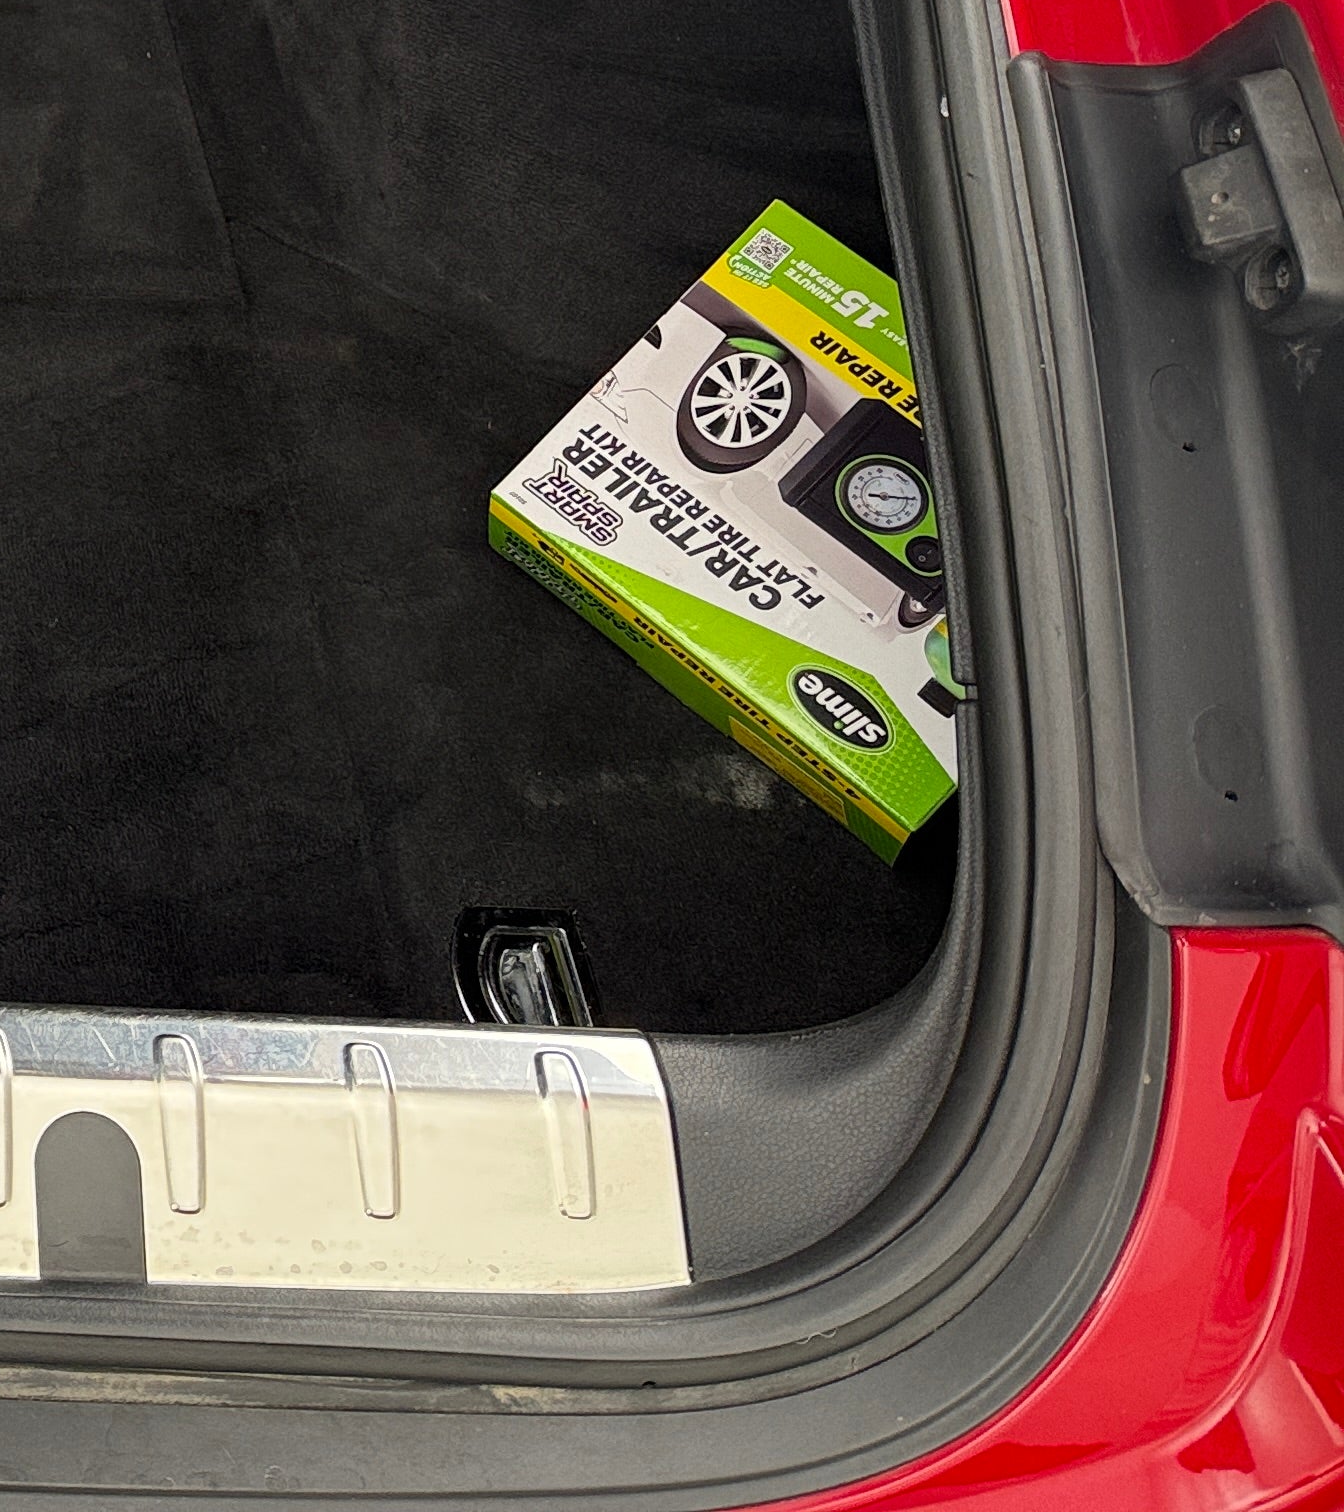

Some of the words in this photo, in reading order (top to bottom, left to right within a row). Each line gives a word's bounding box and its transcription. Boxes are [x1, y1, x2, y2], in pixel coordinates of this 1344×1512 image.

[783, 266, 837, 305] MINUTE
[830, 289, 890, 330] 15
[810, 330, 903, 400] REPAIR
[578, 423, 628, 457] KIT
[528, 481, 613, 542] SMART
[548, 464, 618, 527] SPAIR
[620, 450, 711, 521] REPAIR
[562, 437, 782, 611] CAR/TRAILER
[702, 513, 762, 564] TIRE
[755, 559, 826, 610] FLAT
[633, 615, 716, 684] REPAIR
[717, 684, 772, 730] TIRE
[797, 673, 887, 744] slime
